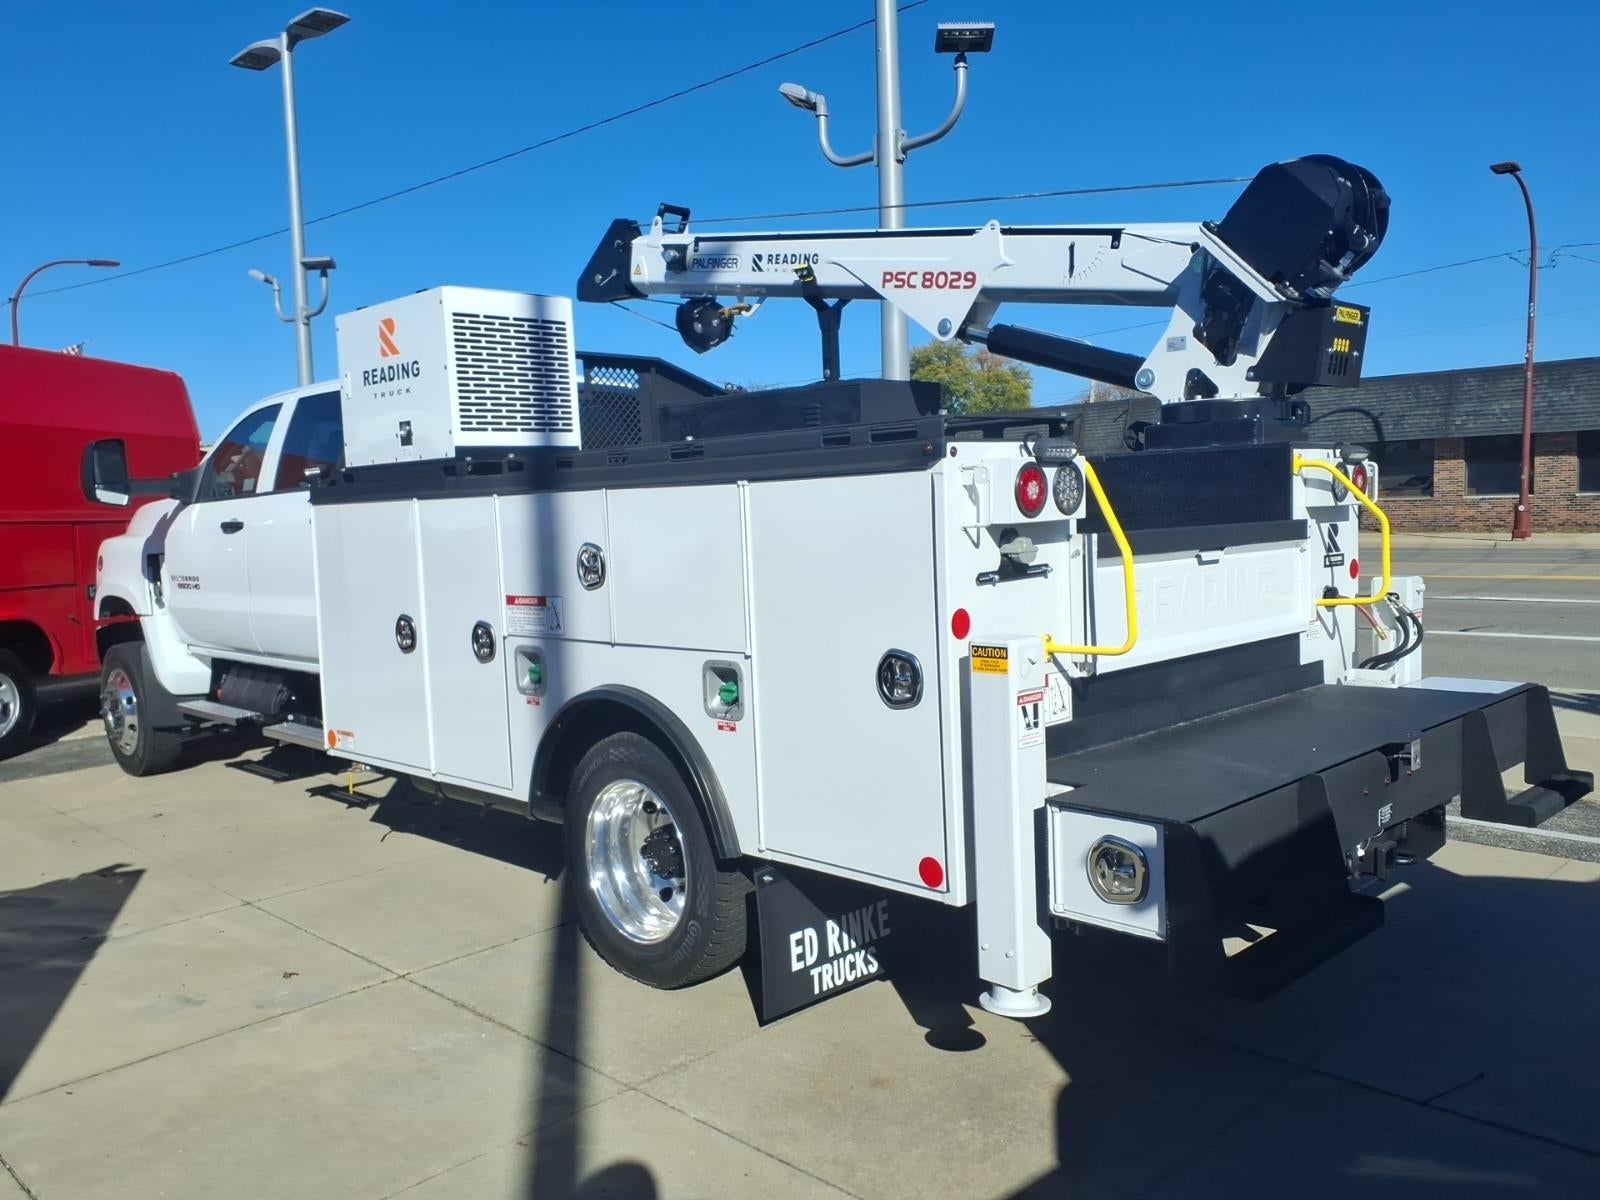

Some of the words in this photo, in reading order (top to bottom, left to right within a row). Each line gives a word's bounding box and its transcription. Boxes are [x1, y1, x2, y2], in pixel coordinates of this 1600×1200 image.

[691, 257, 738, 269] PALFINGER
[767, 253, 819, 264] READING
[882, 271, 918, 289] PSC
[921, 271, 977, 289] 8029
[362, 359, 421, 387] READING
[373, 387, 412, 399] TRUCK
[972, 646, 1007, 659] CAUTION
[789, 927, 819, 973] ED
[826, 900, 891, 958] RINKE
[810, 946, 880, 996] TRUCKS
